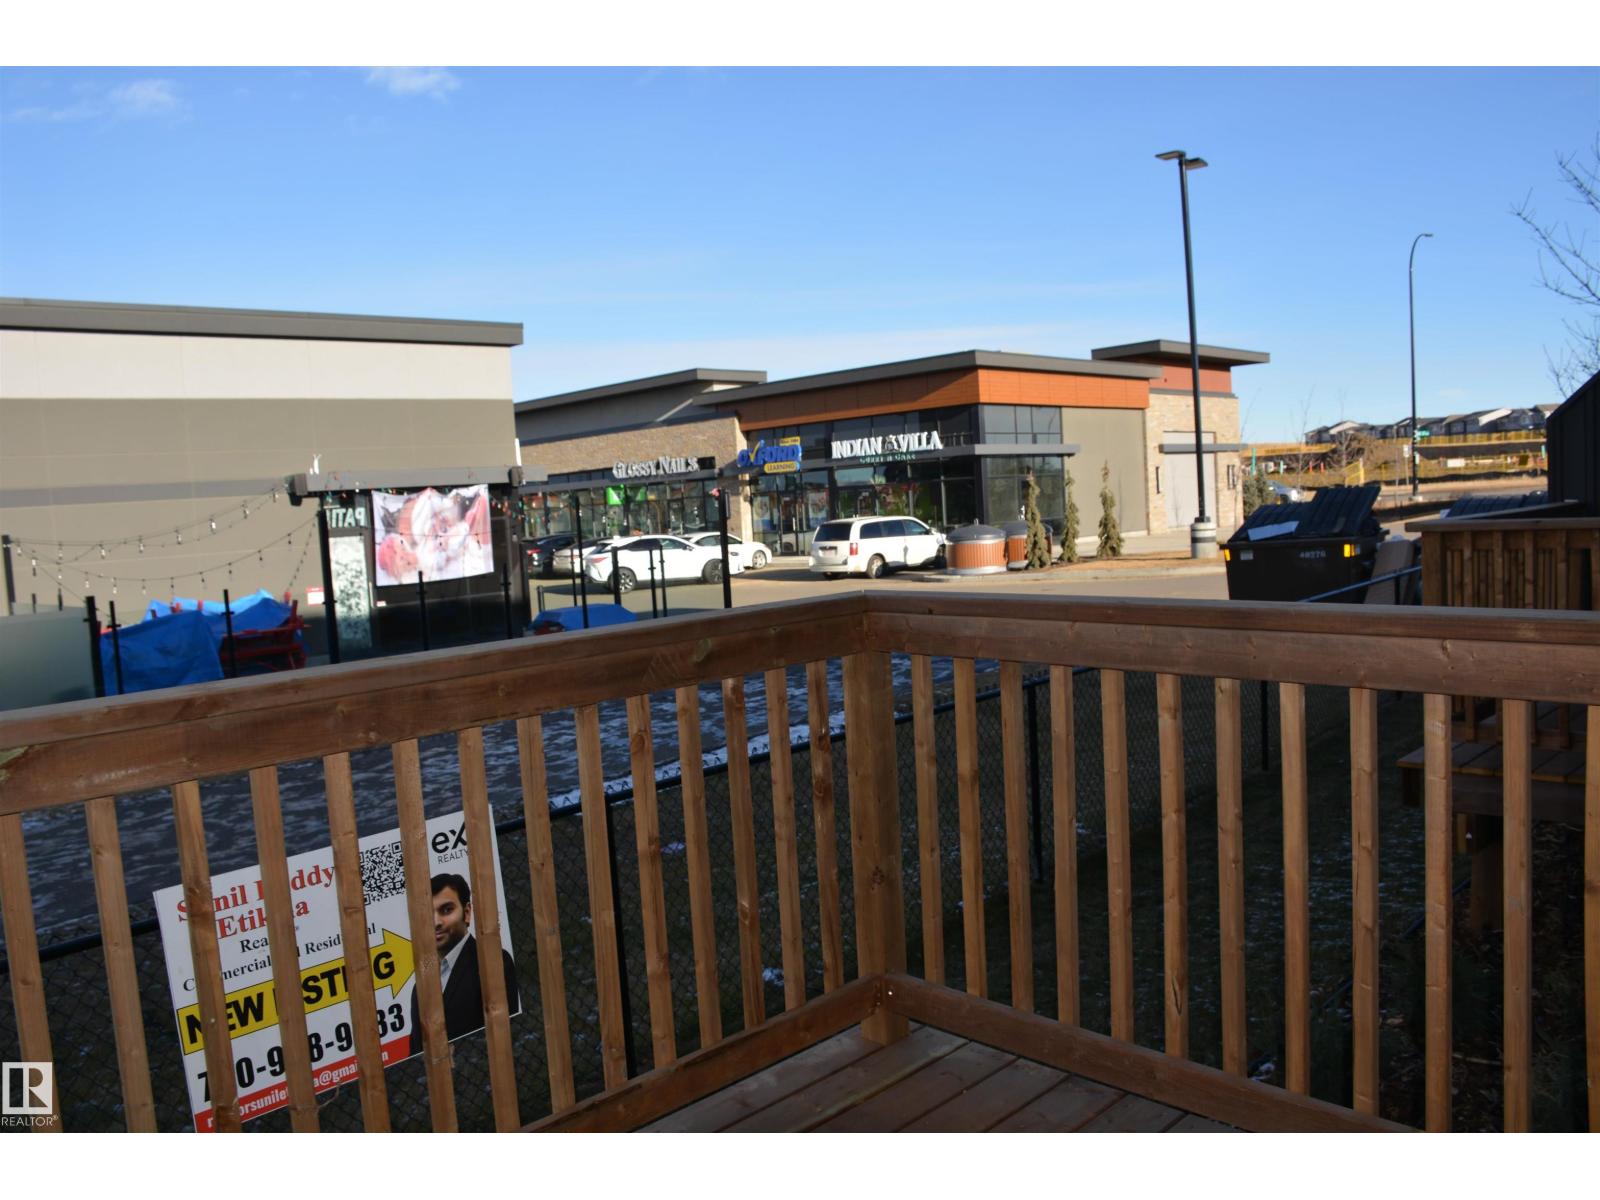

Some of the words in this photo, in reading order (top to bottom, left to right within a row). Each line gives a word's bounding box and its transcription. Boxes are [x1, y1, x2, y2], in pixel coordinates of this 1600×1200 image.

[831, 436, 883, 459] INDIAN
[896, 430, 943, 453] VILLA
[612, 460, 657, 479] GLOSSY
[177, 885, 248, 922] Snil
[254, 865, 335, 900] ddy
